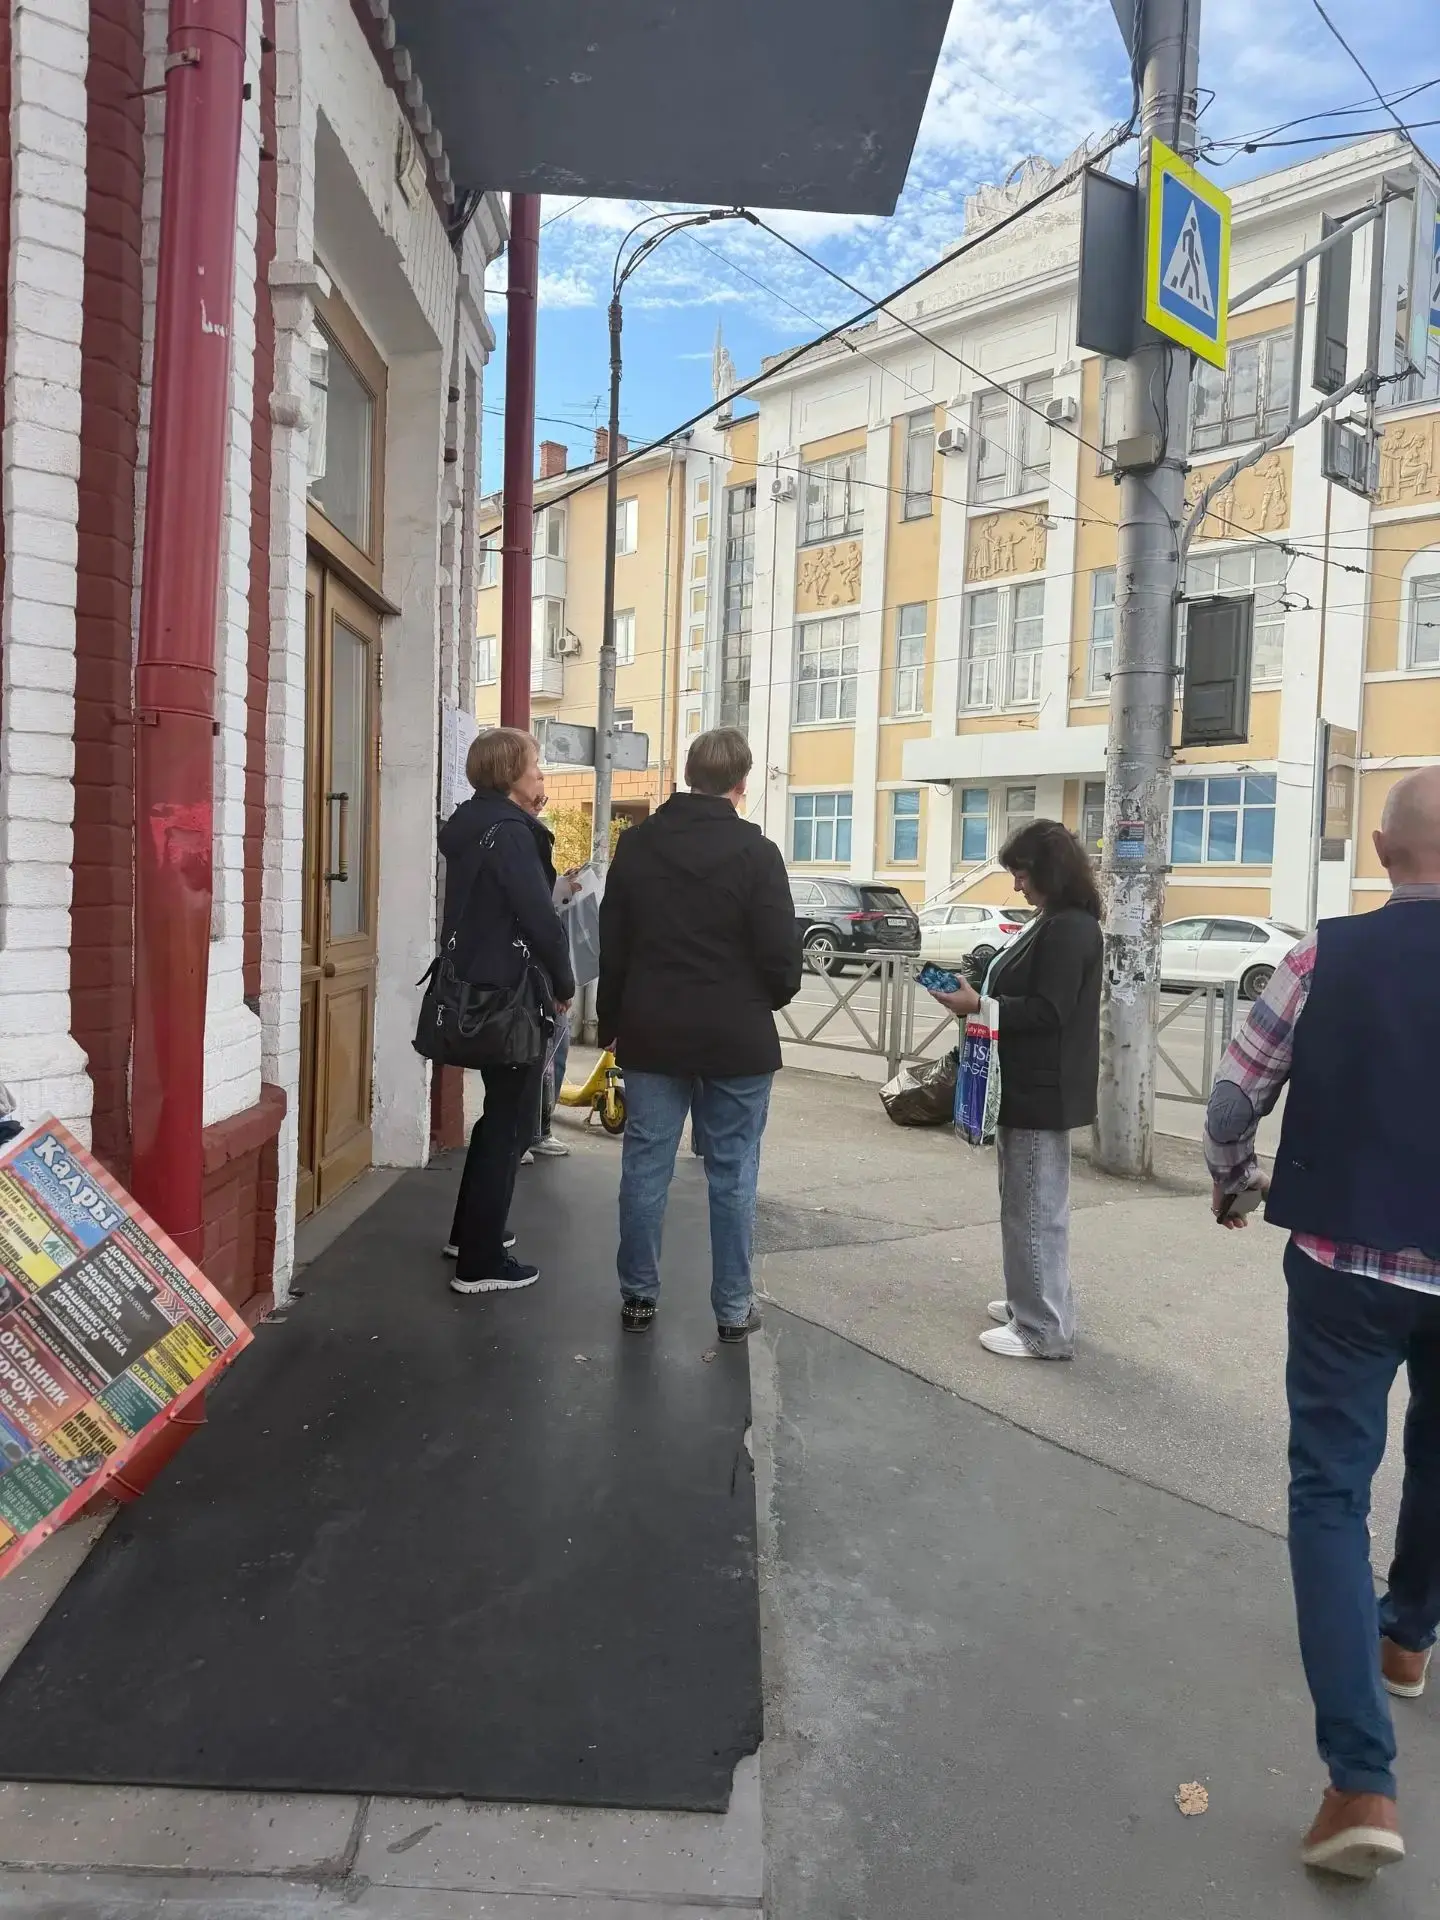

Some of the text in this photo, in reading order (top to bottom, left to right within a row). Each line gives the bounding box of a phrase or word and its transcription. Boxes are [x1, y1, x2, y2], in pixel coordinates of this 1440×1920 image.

[32, 1132, 119, 1230] Кадры
[98, 1250, 137, 1290] РАБОЧИЙ
[106, 1243, 155, 1293] ДОРОЖНЫЙ
[118, 1223, 147, 1255] САМАРЫ,
[144, 1251, 167, 1276] ВАХТА,
[163, 1273, 210, 1325] КОМАНДИРОВКИ
[125, 1217, 157, 1253] ВАКАНСИИ
[154, 1250, 191, 1290] САМАРСКОЙ
[75, 1268, 122, 1321] САМОСВАЛА
[83, 1262, 124, 1306] ВОДИТЕЛЬ
[49, 1287, 100, 1341] ДОРОЖНОГО
[59, 1281, 106, 1331] МАШИНИСТ
[100, 1326, 128, 1357] КАТКА
[0, 1328, 70, 1407] ОХРАННИК
[130, 1362, 173, 1404] ОХРАННИКИ
[0, 1387, 43, 1438] 981-92-00
